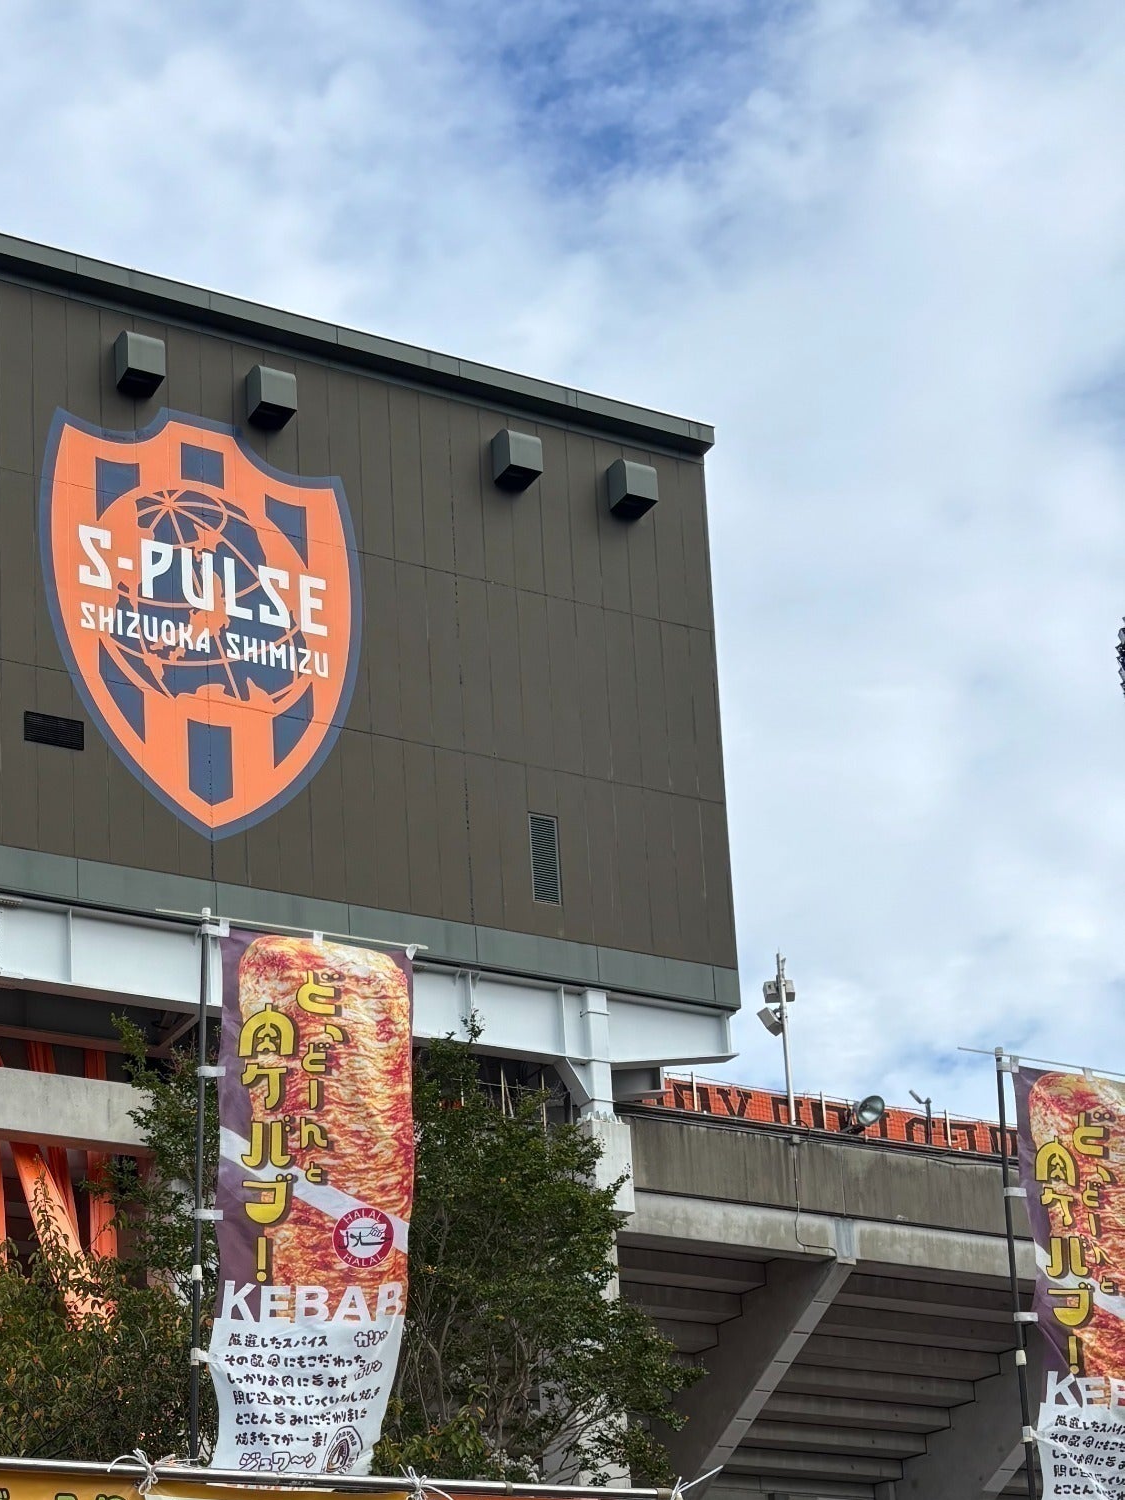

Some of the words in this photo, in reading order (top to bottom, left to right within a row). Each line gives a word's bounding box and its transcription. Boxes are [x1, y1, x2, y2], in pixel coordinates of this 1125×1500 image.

[78, 524, 329, 637] S-PULSE
[80, 601, 211, 654] SHIZUOKA
[225, 632, 330, 679] SHIMIZU
[342, 1209, 382, 1225] HALAL
[342, 1253, 385, 1267] HALAL
[220, 1280, 406, 1323] KEBAB
